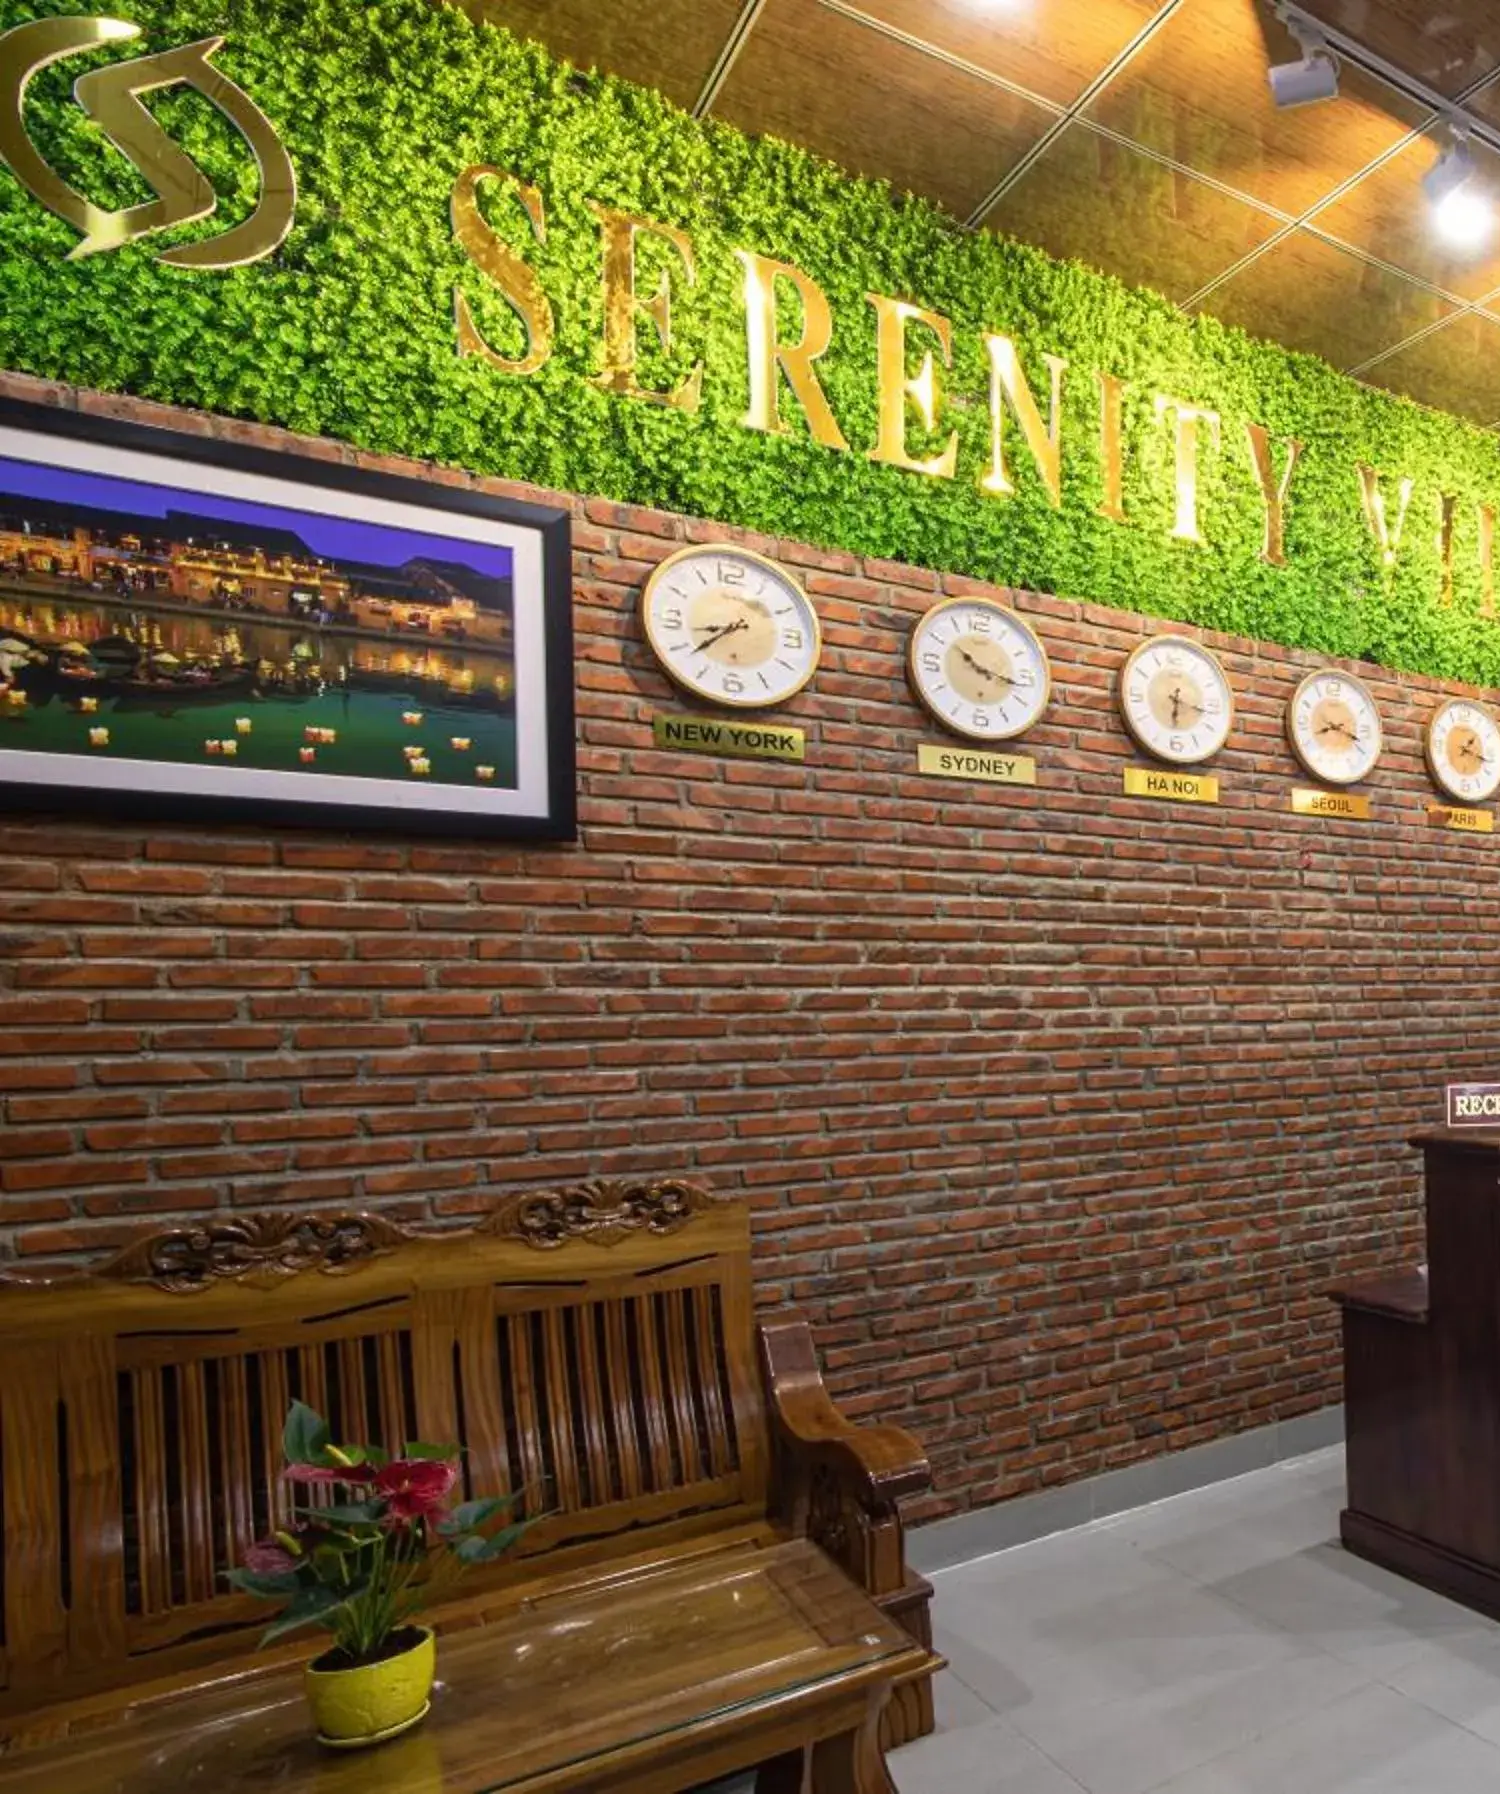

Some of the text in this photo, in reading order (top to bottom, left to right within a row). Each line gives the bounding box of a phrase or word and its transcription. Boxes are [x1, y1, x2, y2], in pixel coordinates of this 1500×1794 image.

[450, 164, 1303, 567] SERENITY
[717, 560, 746, 587] 12
[783, 628, 803, 649] 3
[721, 672, 745, 694] 6
[665, 722, 796, 752] NEW YORK
[939, 753, 1016, 777] SYDNEY
[1147, 776, 1199, 796] HA NOI
[1311, 796, 1353, 813] SEOUL
